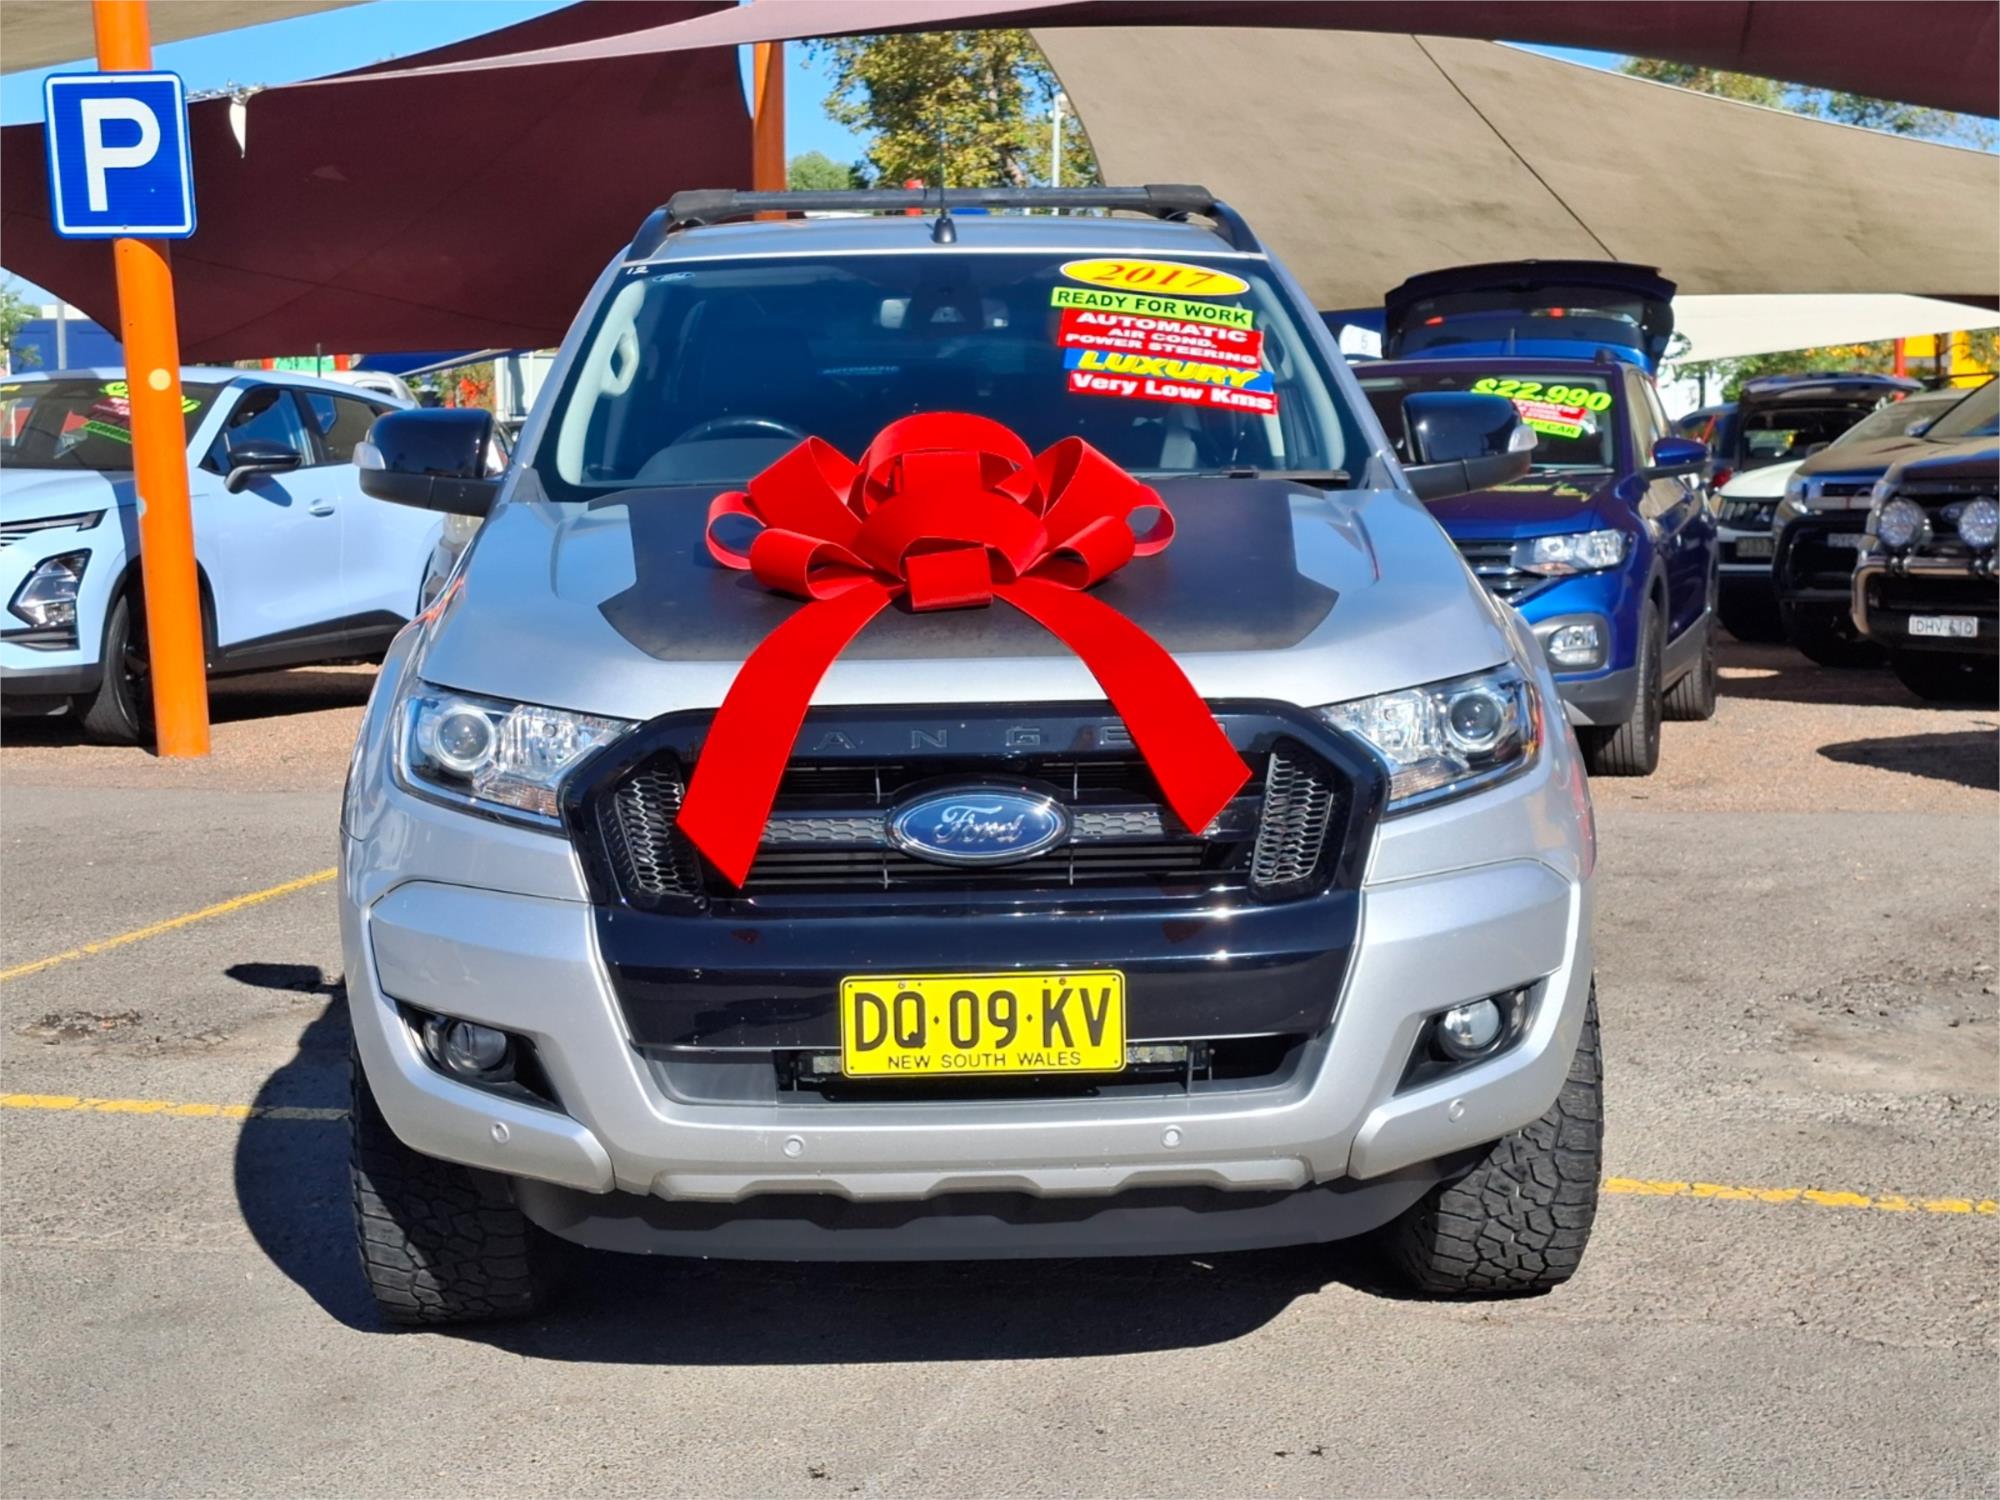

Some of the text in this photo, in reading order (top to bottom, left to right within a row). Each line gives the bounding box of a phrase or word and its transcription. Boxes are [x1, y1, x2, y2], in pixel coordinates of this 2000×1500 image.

[80, 97, 161, 212] P
[1093, 263, 1218, 289] 2017
[1057, 291, 1248, 325] READY FOR WORK
[1076, 311, 1248, 342] AUTOMATIC
[1108, 328, 1146, 340] AIR
[1065, 333, 1258, 365] POWER STEERING
[1078, 350, 1260, 388] LUXURY
[1072, 373, 1274, 410] Very Low Kms
[934, 803, 1023, 844] Ford
[888, 1051, 1081, 1070] NEW SOUTH WALES
